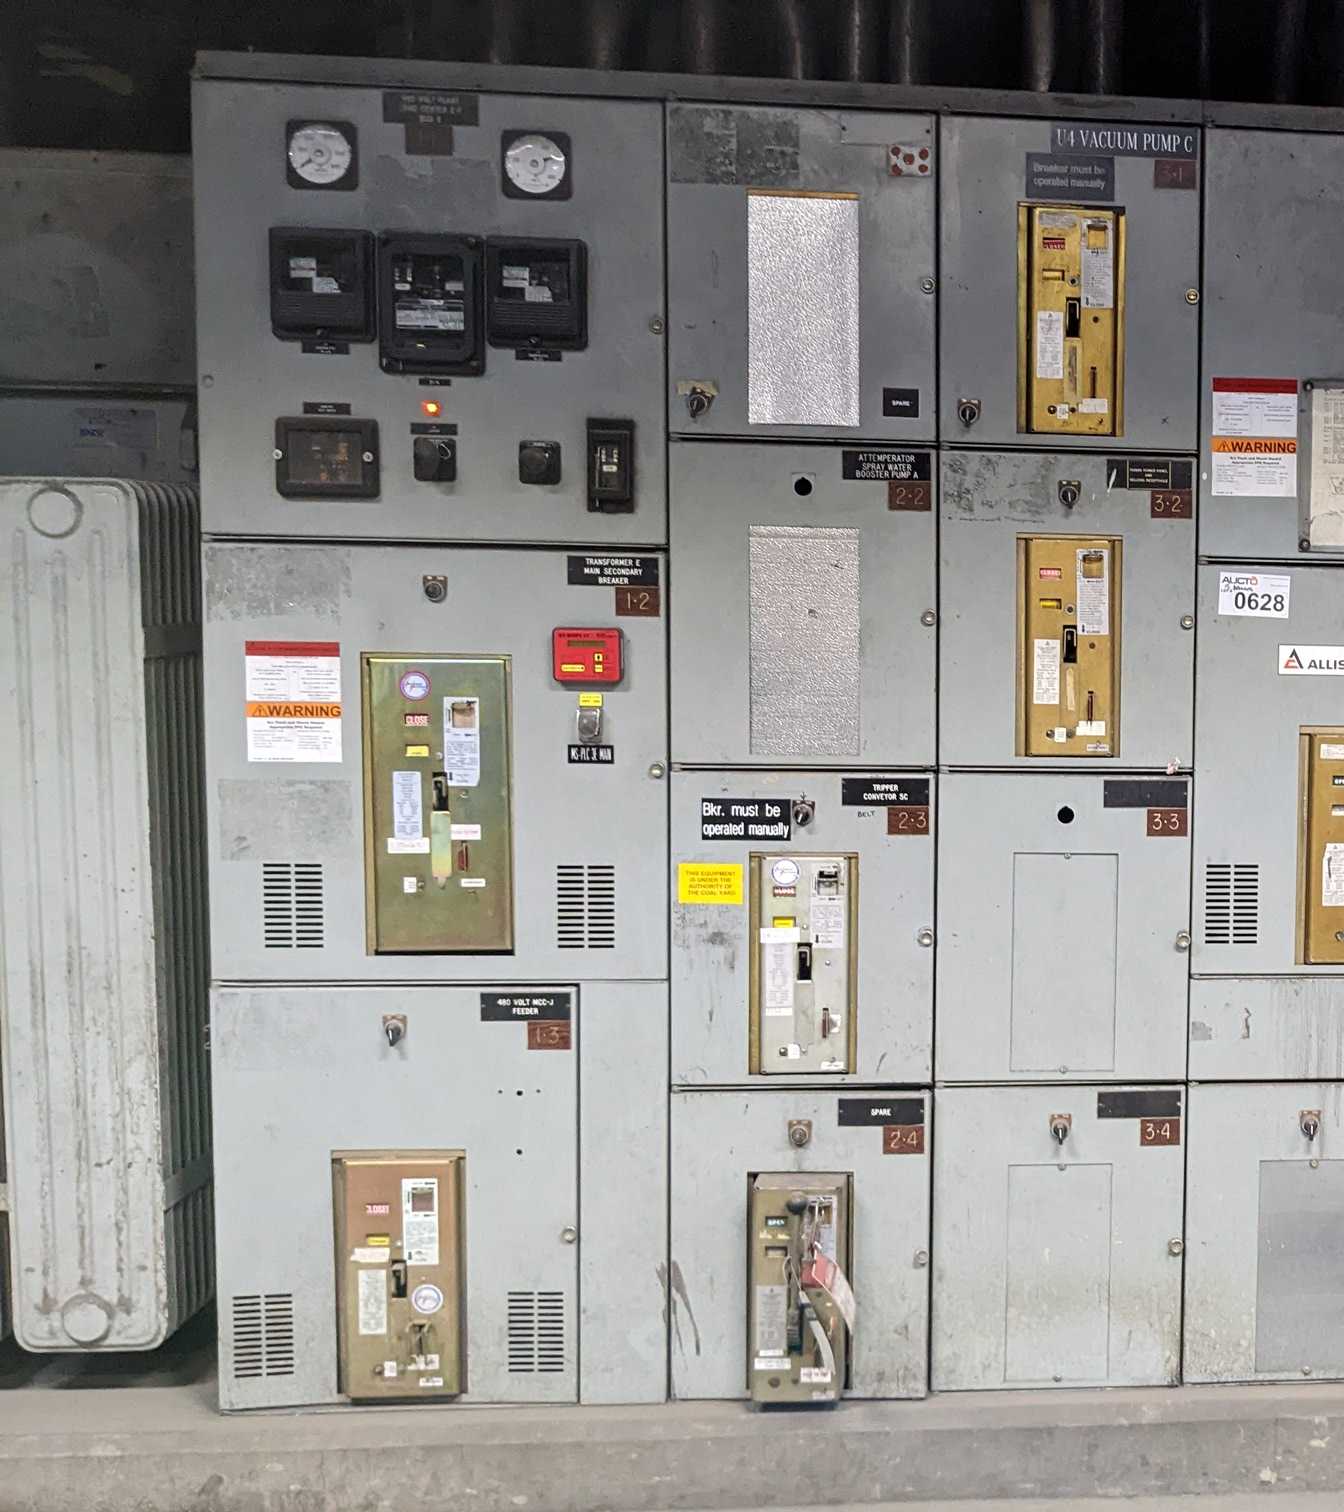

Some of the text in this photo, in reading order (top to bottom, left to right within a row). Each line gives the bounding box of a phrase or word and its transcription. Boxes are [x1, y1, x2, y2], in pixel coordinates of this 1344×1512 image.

[1056, 128, 1193, 153] U4 VACUUM PUMP C
[1071, 165, 1092, 175] must
[1094, 164, 1106, 175] be
[1033, 177, 1107, 191] operated manually
[1231, 441, 1297, 454] WARNING
[858, 453, 916, 463] ATTEMPERATOR
[862, 462, 912, 472] SPRAY WATER
[855, 470, 919, 480] BOOSTER PUMP A
[585, 557, 641, 567] TRANSFORMER E
[583, 567, 643, 576] MAIN SECONDARY
[598, 576, 629, 585] BREAKER
[1234, 591, 1285, 612] 0628
[267, 704, 342, 718] WARNING
[872, 783, 899, 792] TRIPPER
[863, 792, 898, 801] CONVEYOR
[702, 801, 781, 817] Bkr. must be
[702, 822, 790, 839] operated manually
[513, 998, 530, 1006] VOLT
[512, 1007, 539, 1015] FEEDER
[870, 1107, 892, 1117] SPARE
